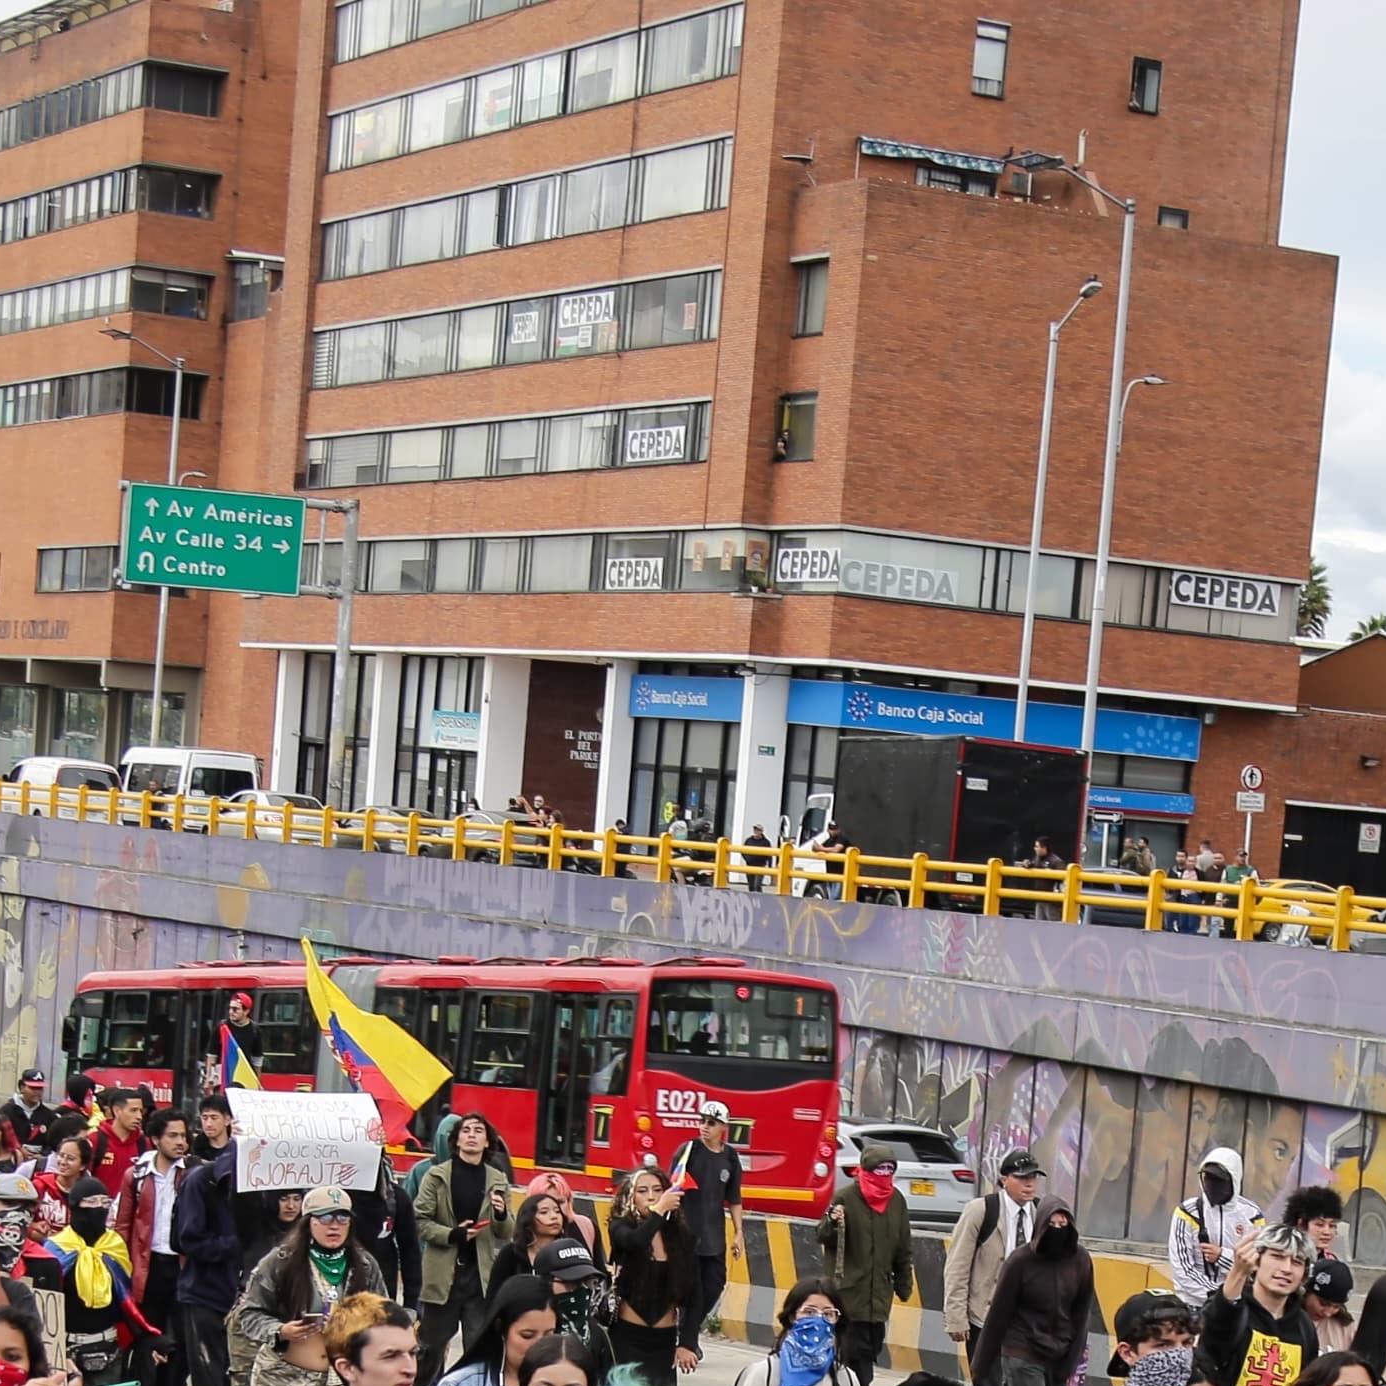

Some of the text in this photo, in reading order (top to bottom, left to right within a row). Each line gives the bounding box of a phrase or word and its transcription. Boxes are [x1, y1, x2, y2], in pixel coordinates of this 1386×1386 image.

[561, 295, 613, 325] CEPEDA
[629, 429, 683, 460] CEPEDA
[166, 500, 294, 528] Av Américas
[138, 526, 263, 552] Av Calle 34
[163, 556, 227, 577] Centro
[608, 559, 662, 588] CEPEDA
[779, 549, 840, 580] CEPEDA
[840, 561, 956, 602] CEPEDA
[1174, 574, 1277, 613] CEPEDA
[877, 702, 984, 726] Banco Caja Social
[274, 1140, 340, 1160] QUE SER
